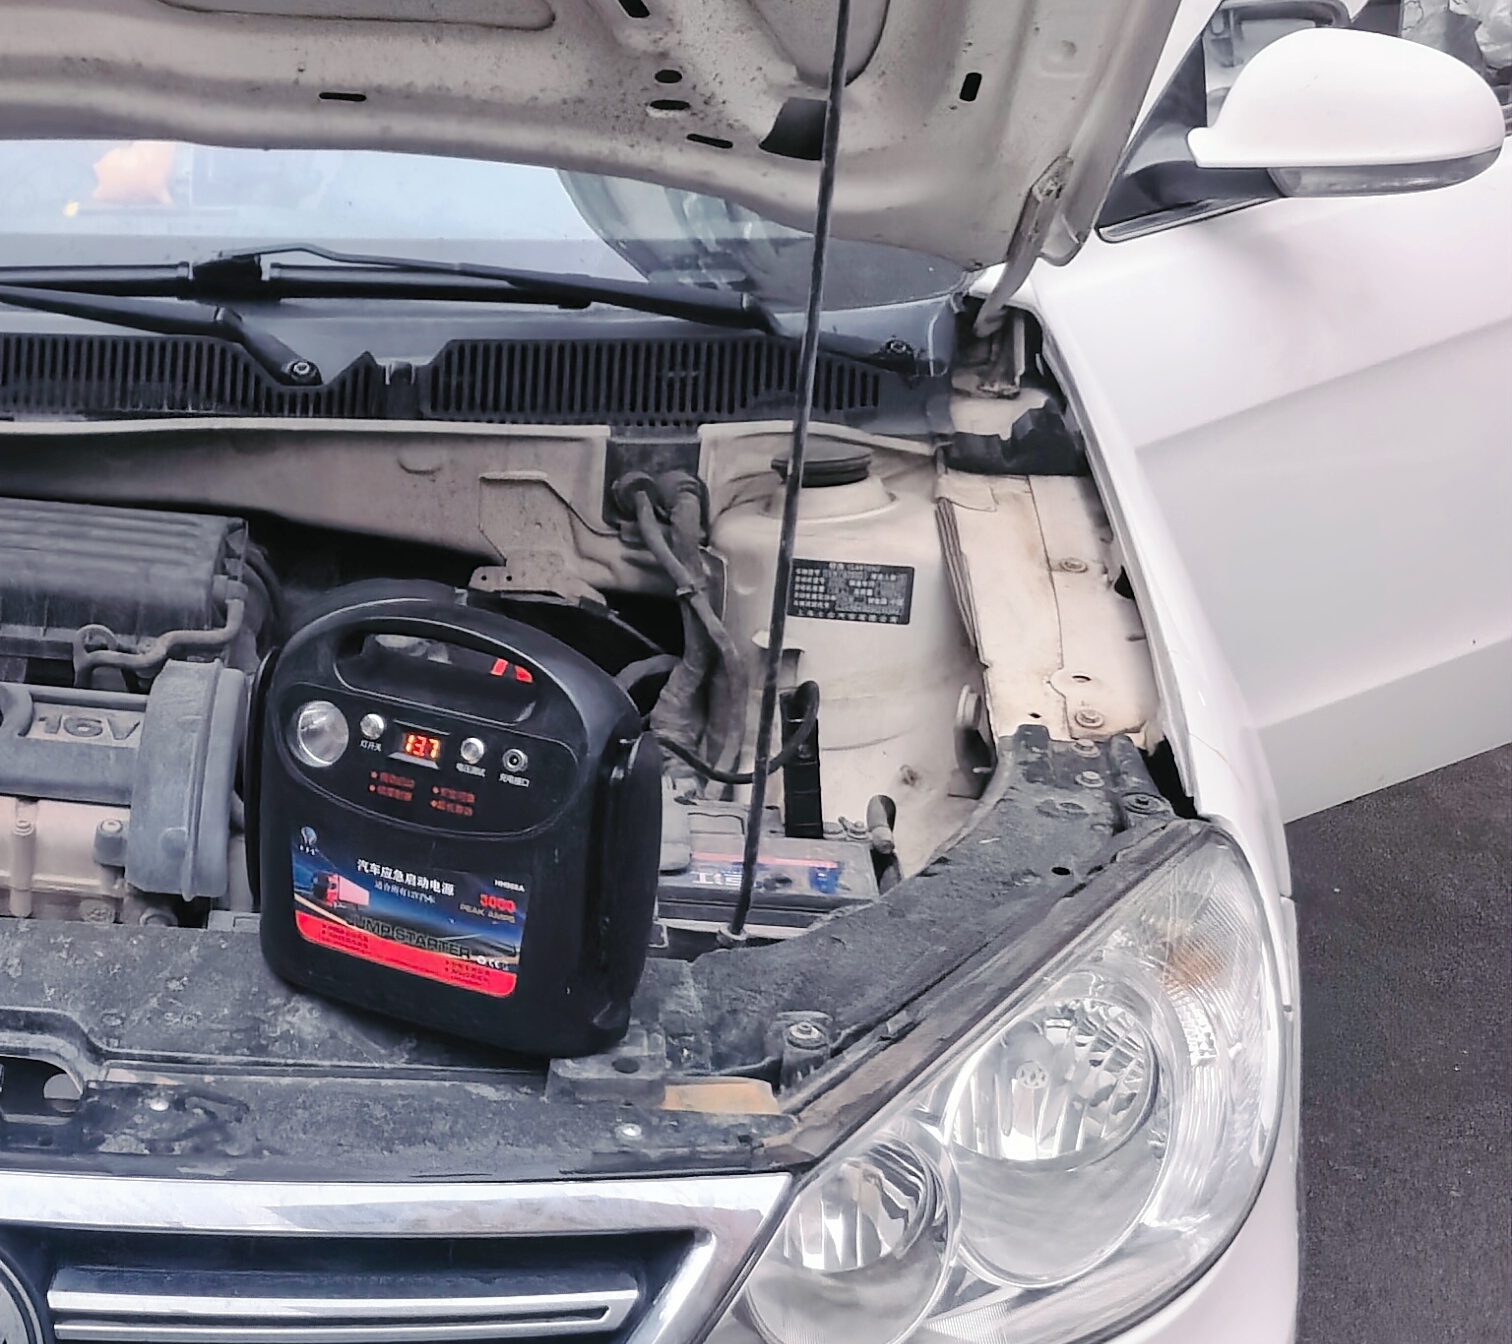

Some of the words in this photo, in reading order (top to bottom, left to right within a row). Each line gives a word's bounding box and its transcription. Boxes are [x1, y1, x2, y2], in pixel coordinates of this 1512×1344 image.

[38, 714, 141, 740] 16V
[356, 858, 455, 896] 汽车应急启动电源
[393, 925, 472, 959] STARTER
